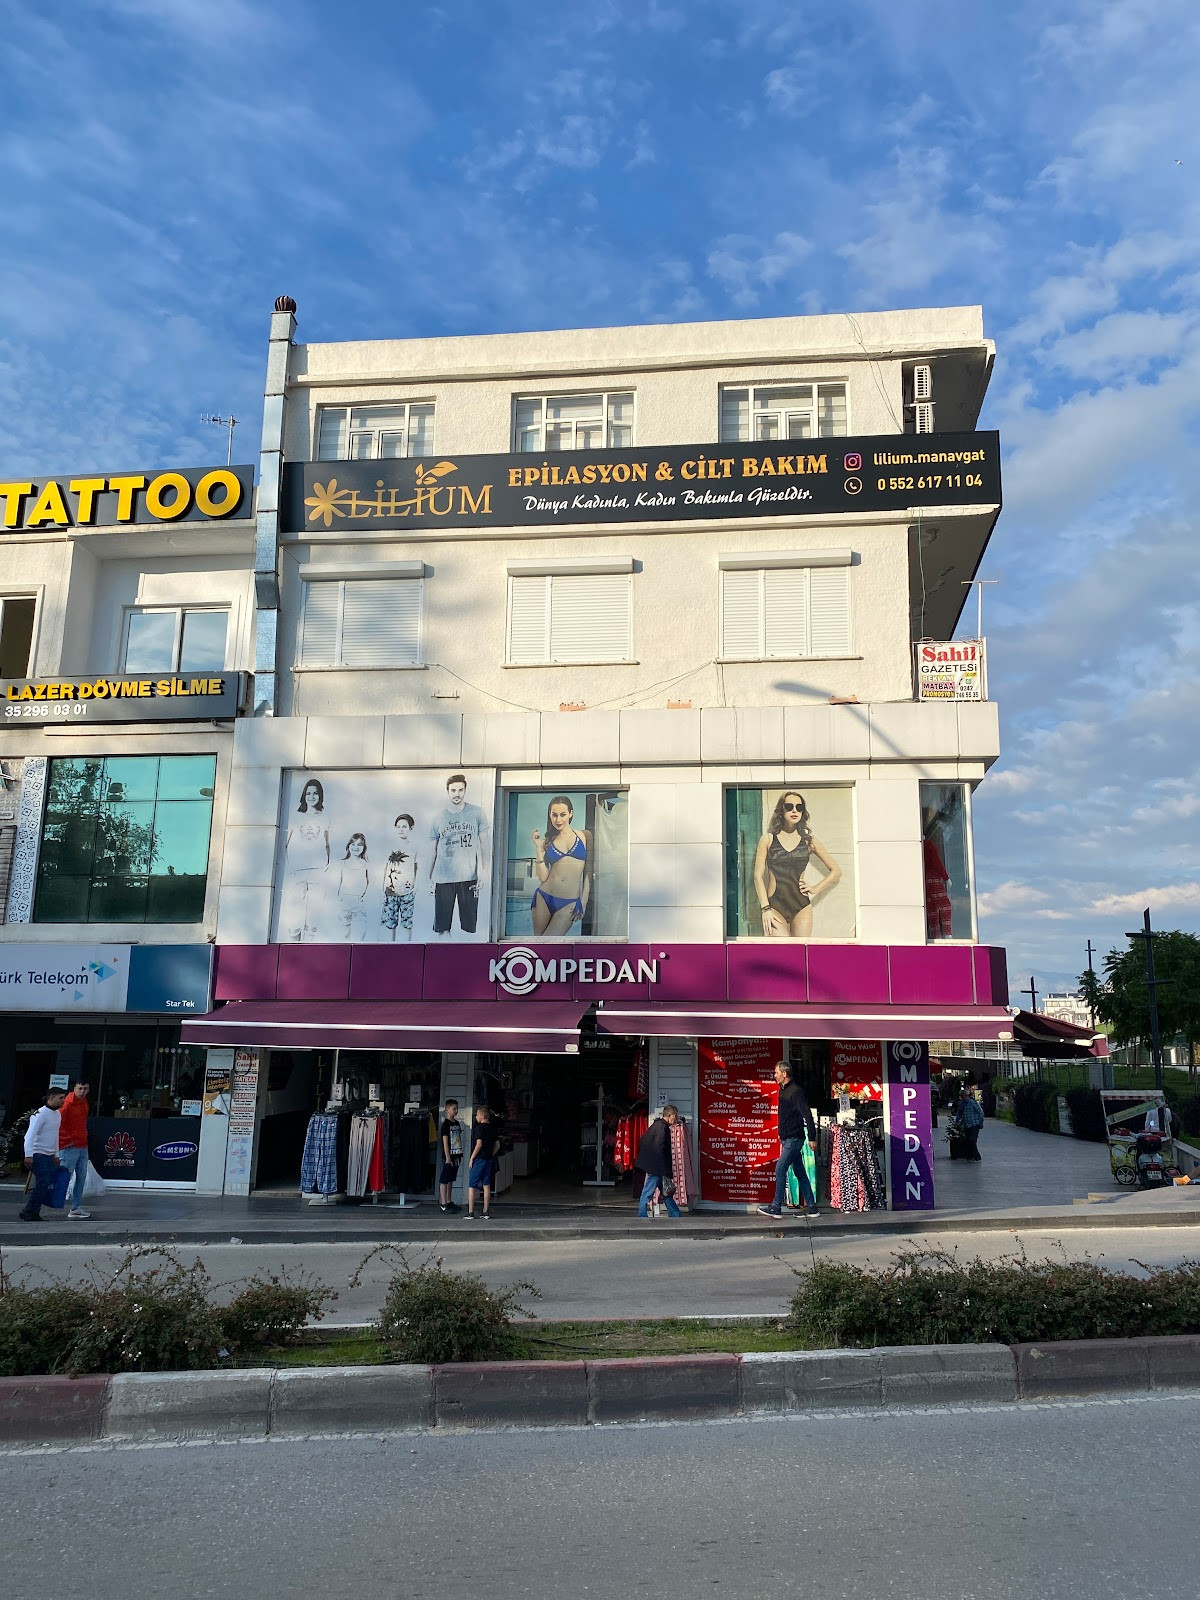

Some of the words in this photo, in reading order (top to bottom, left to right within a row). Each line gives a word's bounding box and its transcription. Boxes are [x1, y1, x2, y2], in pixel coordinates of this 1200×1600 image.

[873, 449, 986, 466] lilium.manavgat
[508, 461, 648, 487] EPİLASYON
[655, 461, 674, 481] &
[680, 454, 734, 480] CİLT
[742, 454, 829, 477] BAKIM
[877, 478, 886, 491] 0
[889, 476, 914, 490] 552
[917, 475, 942, 489] 617
[946, 474, 961, 488] 11
[965, 473, 983, 487] 04
[0, 469, 241, 527] TATTOO
[523, 495, 567, 514] Dünya
[571, 494, 630, 509] Kadınla,
[634, 491, 676, 507] Kadın
[680, 489, 743, 505] Bakımla
[747, 486, 813, 506] Güzeldir.
[922, 646, 976, 662] Sahil
[7, 683, 75, 700] LAZER
[79, 679, 152, 699] DÖVME
[157, 676, 222, 696] SİLME
[23, 704, 49, 717] 296
[53, 704, 70, 716] 03
[73, 703, 88, 715] 01
[28, 971, 89, 985] Telekom
[488, 947, 657, 995] KOMPEDAN
[166, 1000, 181, 1008] Star
[182, 1000, 195, 1008] Tek
[834, 1053, 878, 1066] KOMPEDAN
